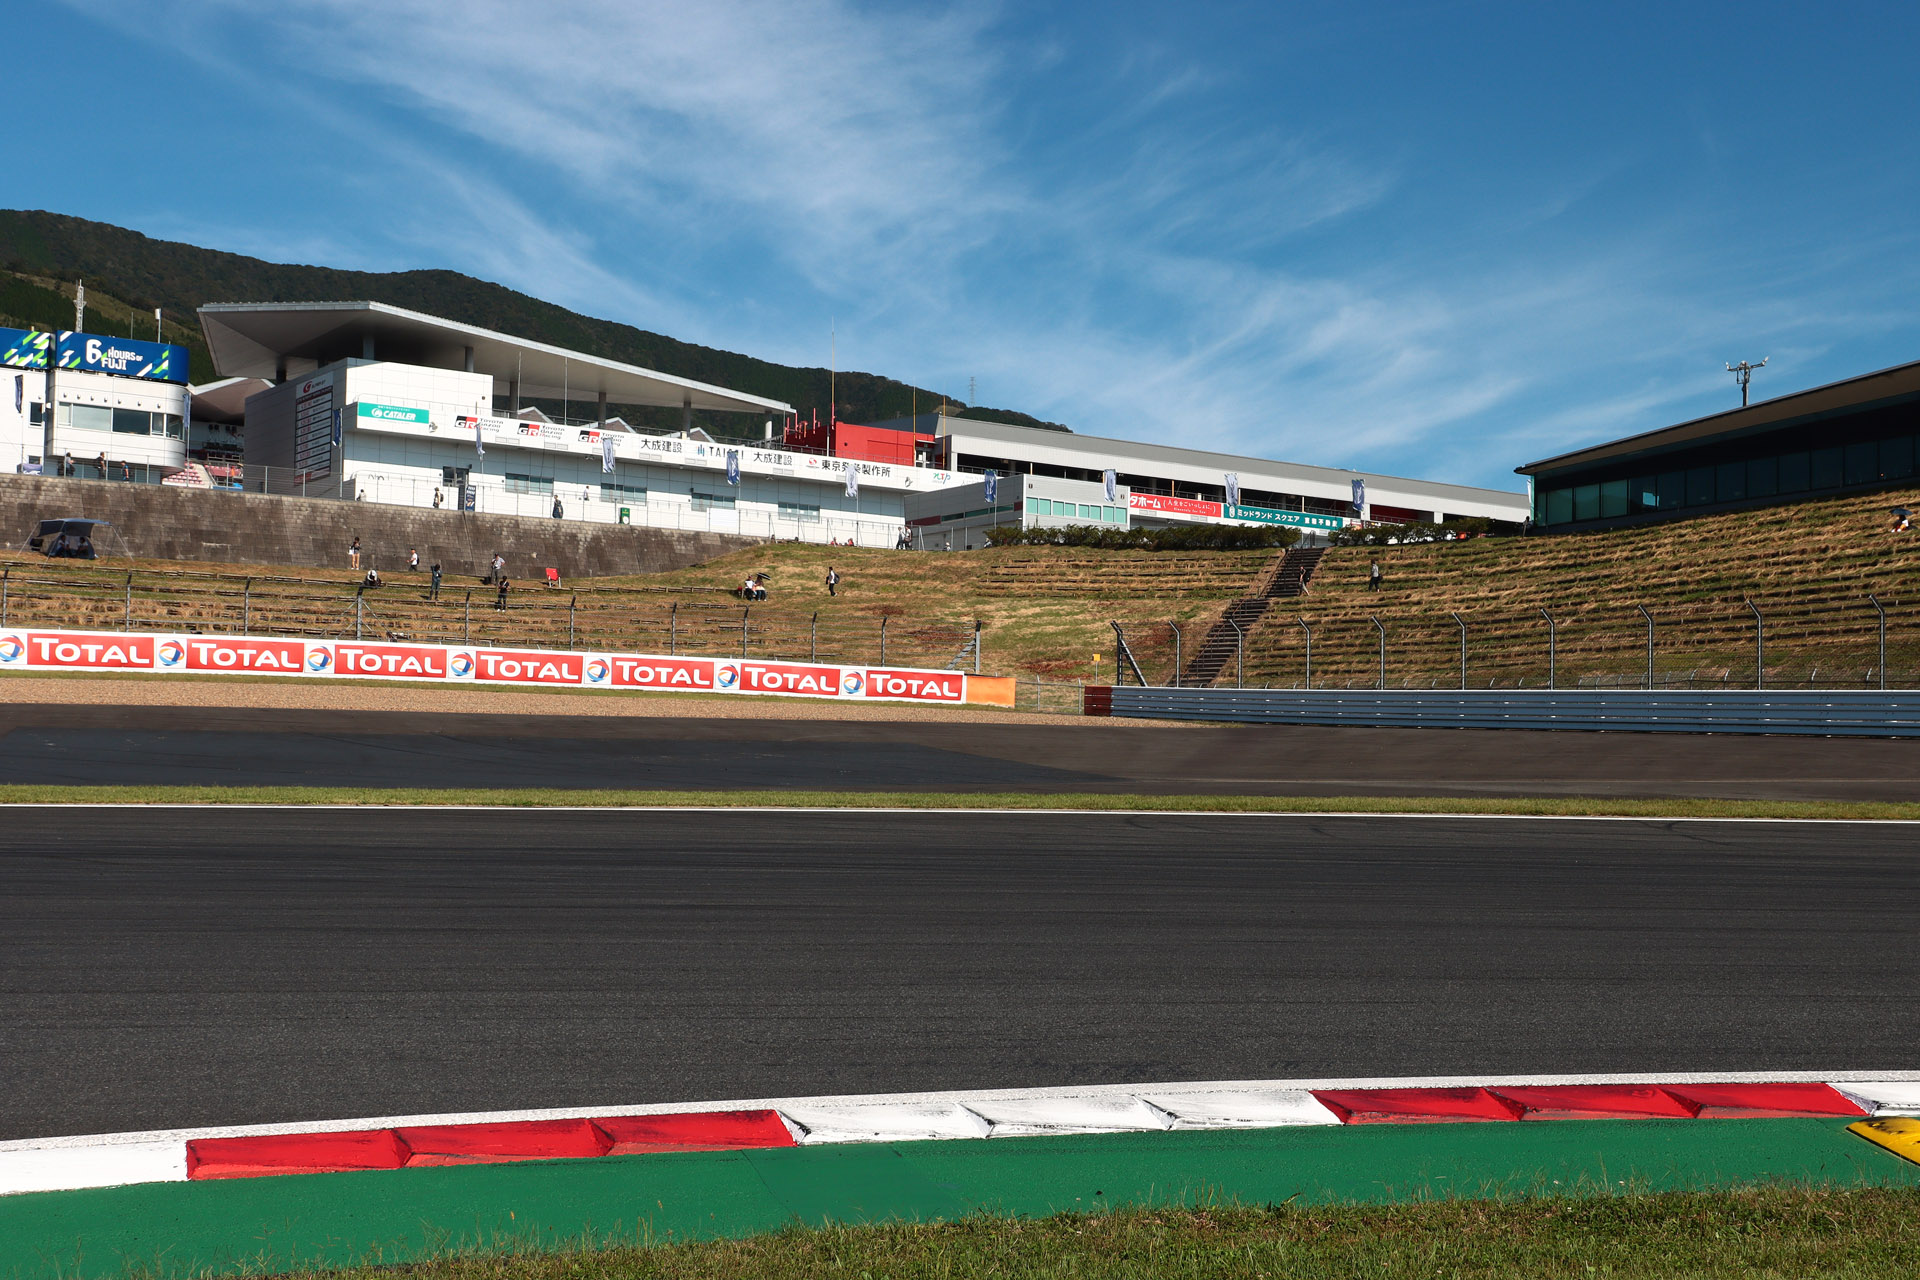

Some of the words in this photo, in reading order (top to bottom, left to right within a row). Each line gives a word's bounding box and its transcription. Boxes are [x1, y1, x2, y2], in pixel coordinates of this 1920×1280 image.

[86, 339, 102, 364] 6
[107, 346, 136, 361] HOURS
[101, 358, 127, 370] FUJI
[383, 410, 417, 421] CATALER
[641, 438, 683, 453] 大成建設
[709, 446, 744, 460] TAII
[753, 451, 793, 466] 大成建設
[32, 638, 150, 663] TOTAL
[192, 643, 300, 668] TOTAL
[339, 649, 443, 674] TOTAL
[480, 655, 579, 680] TOTAL
[616, 661, 711, 686] TOTAL
[745, 667, 837, 692] TOTAL
[870, 674, 959, 698] TOTAL
